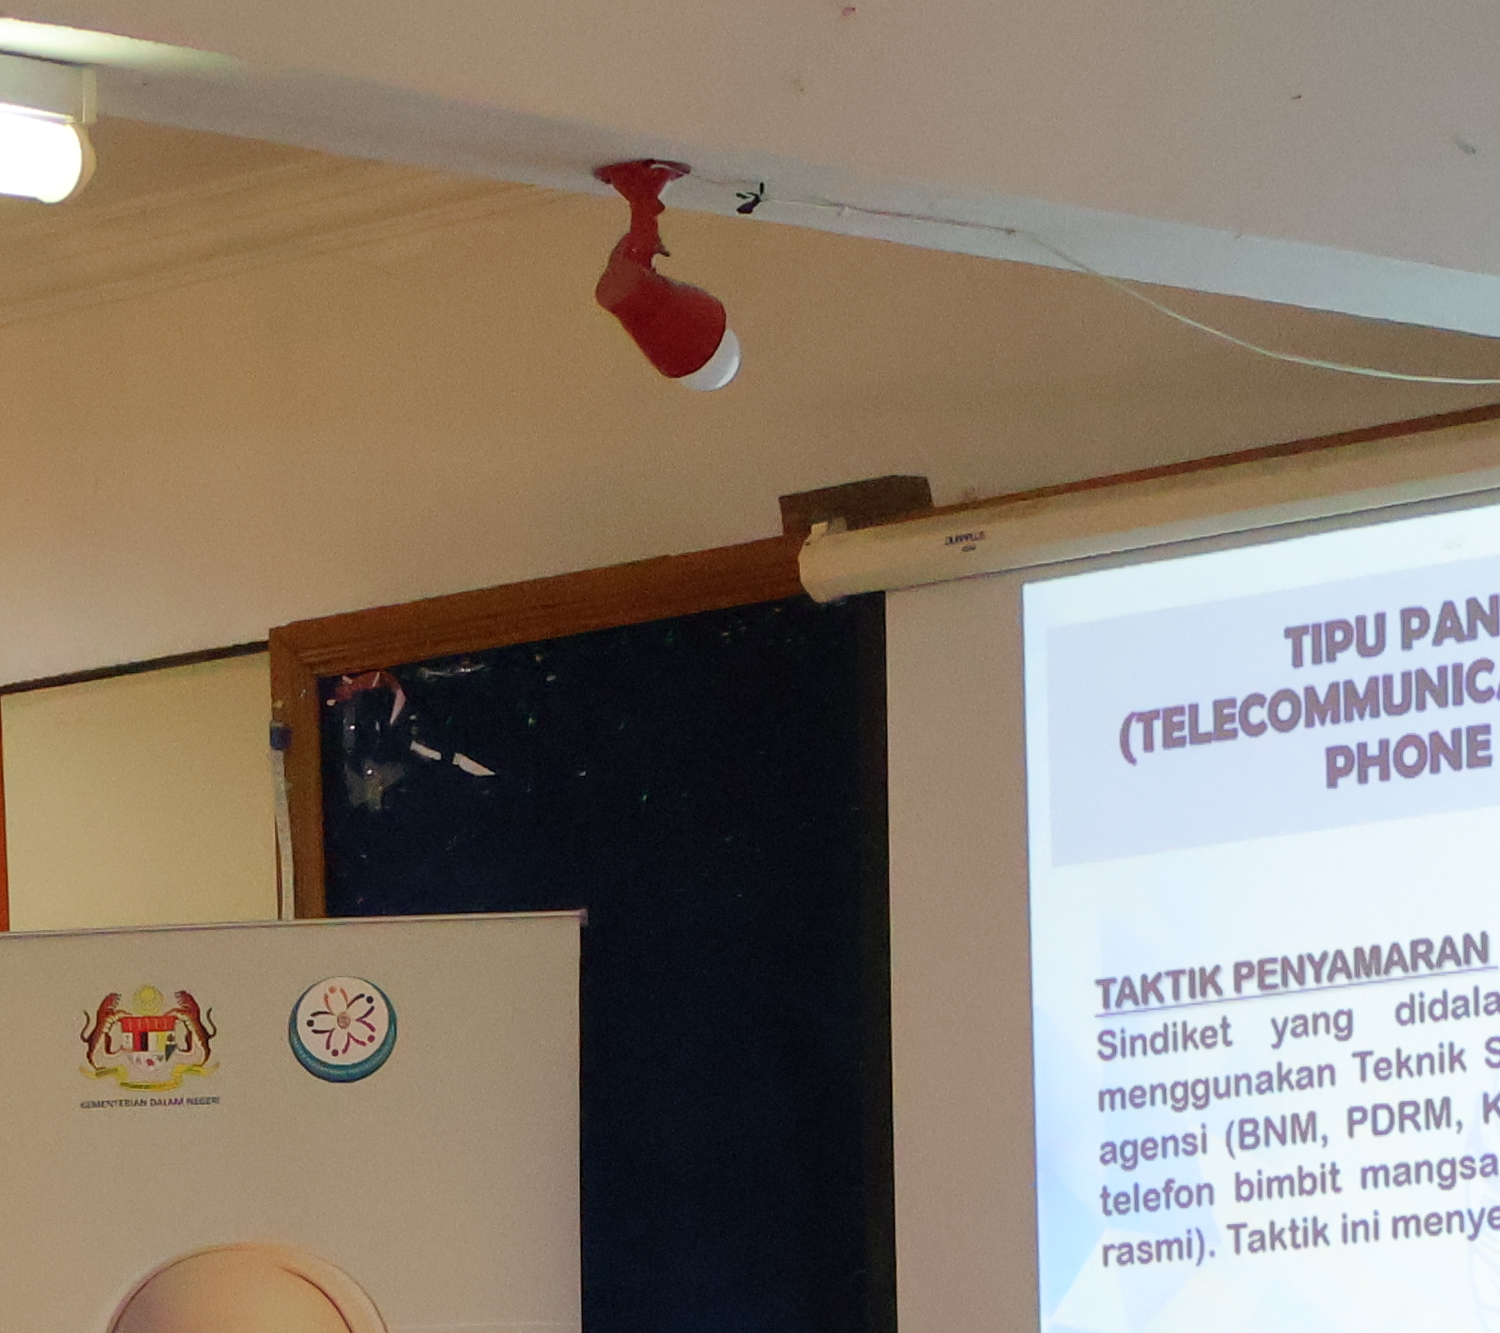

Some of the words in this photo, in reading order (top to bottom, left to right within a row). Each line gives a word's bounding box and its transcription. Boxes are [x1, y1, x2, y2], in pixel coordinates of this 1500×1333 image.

[1282, 610, 1388, 670] TIPU
[1324, 722, 1494, 790] PHONE
[1093, 963, 1224, 1012] TAKTIK
[1232, 930, 1490, 996] PENYAMARAN
[1096, 1014, 1234, 1063] Sindiket
[1269, 1007, 1355, 1051] yang
[150, 1097, 183, 1107] DALAM
[1097, 1060, 1337, 1114] menggunakan
[1350, 1040, 1468, 1084] Teknik
[1098, 1122, 1208, 1173] agensi
[1224, 1109, 1329, 1160] (BNM,
[1346, 1095, 1464, 1140] PDRM,
[1099, 1177, 1215, 1218] telefon
[1233, 1161, 1343, 1204] bimbit
[1101, 1226, 1216, 1268] rasmi).
[1225, 1215, 1331, 1256] Taktik
[1340, 1209, 1380, 1246] ini
